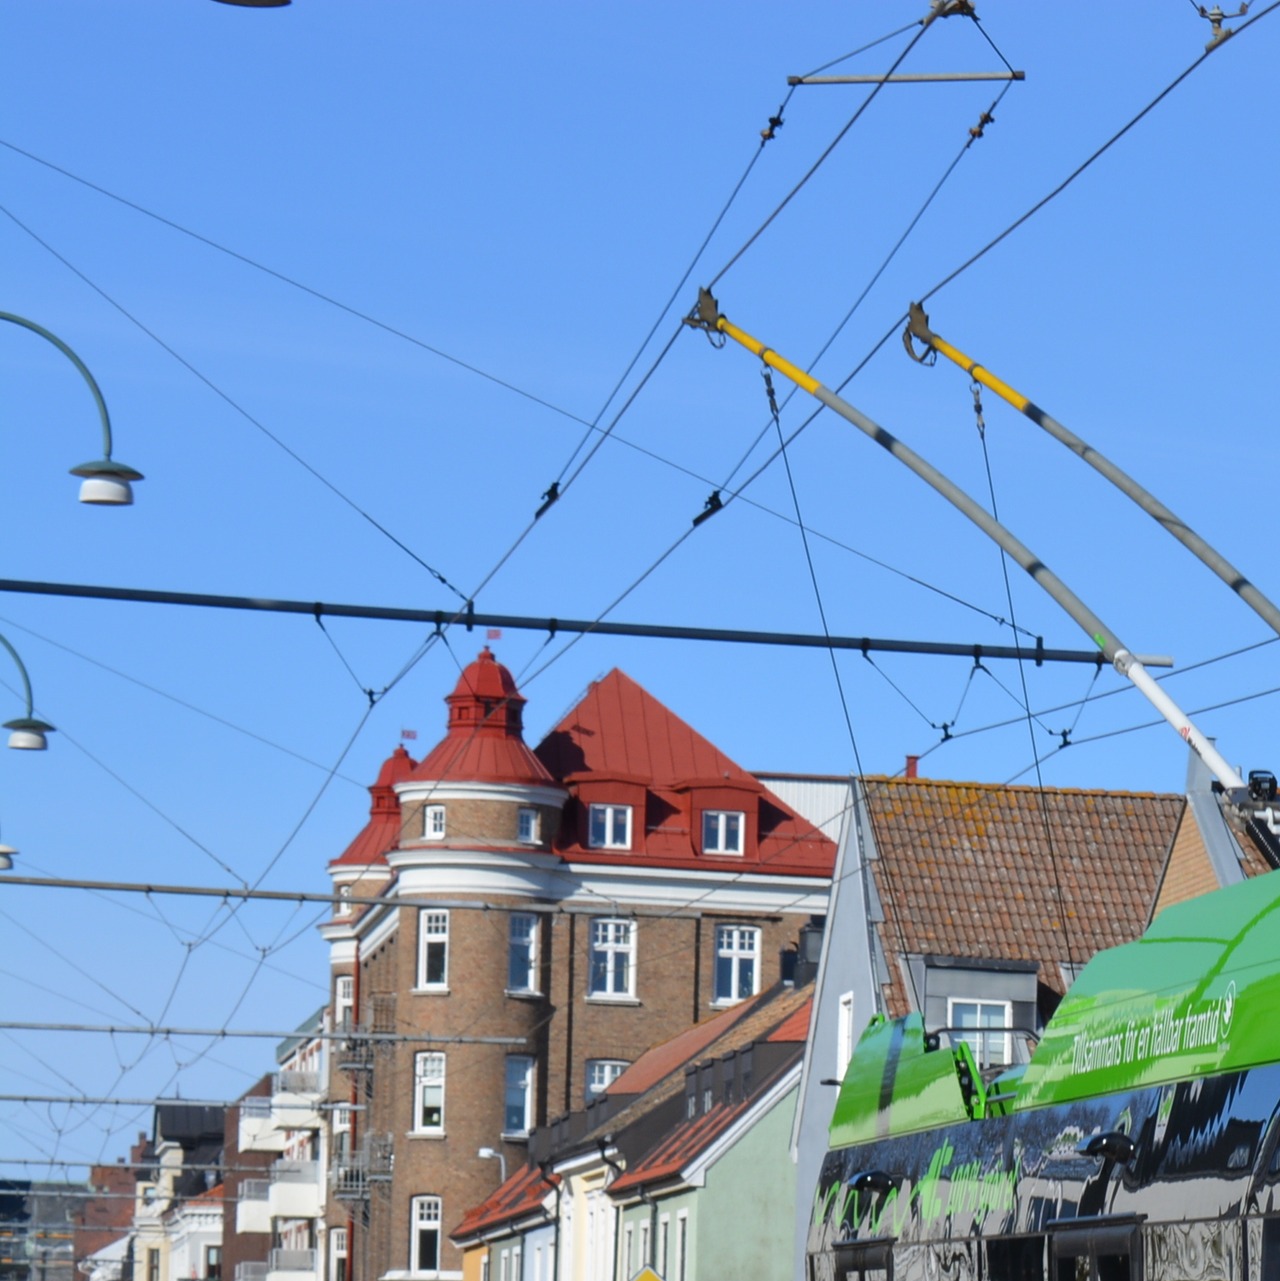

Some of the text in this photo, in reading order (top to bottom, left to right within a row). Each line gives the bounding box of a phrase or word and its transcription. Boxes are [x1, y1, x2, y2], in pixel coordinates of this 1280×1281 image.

[1071, 1029, 1123, 1075] Tillsammans
[1123, 1019, 1138, 1063] för
[1138, 1026, 1151, 1061] en
[1183, 996, 1223, 1050] framtid
